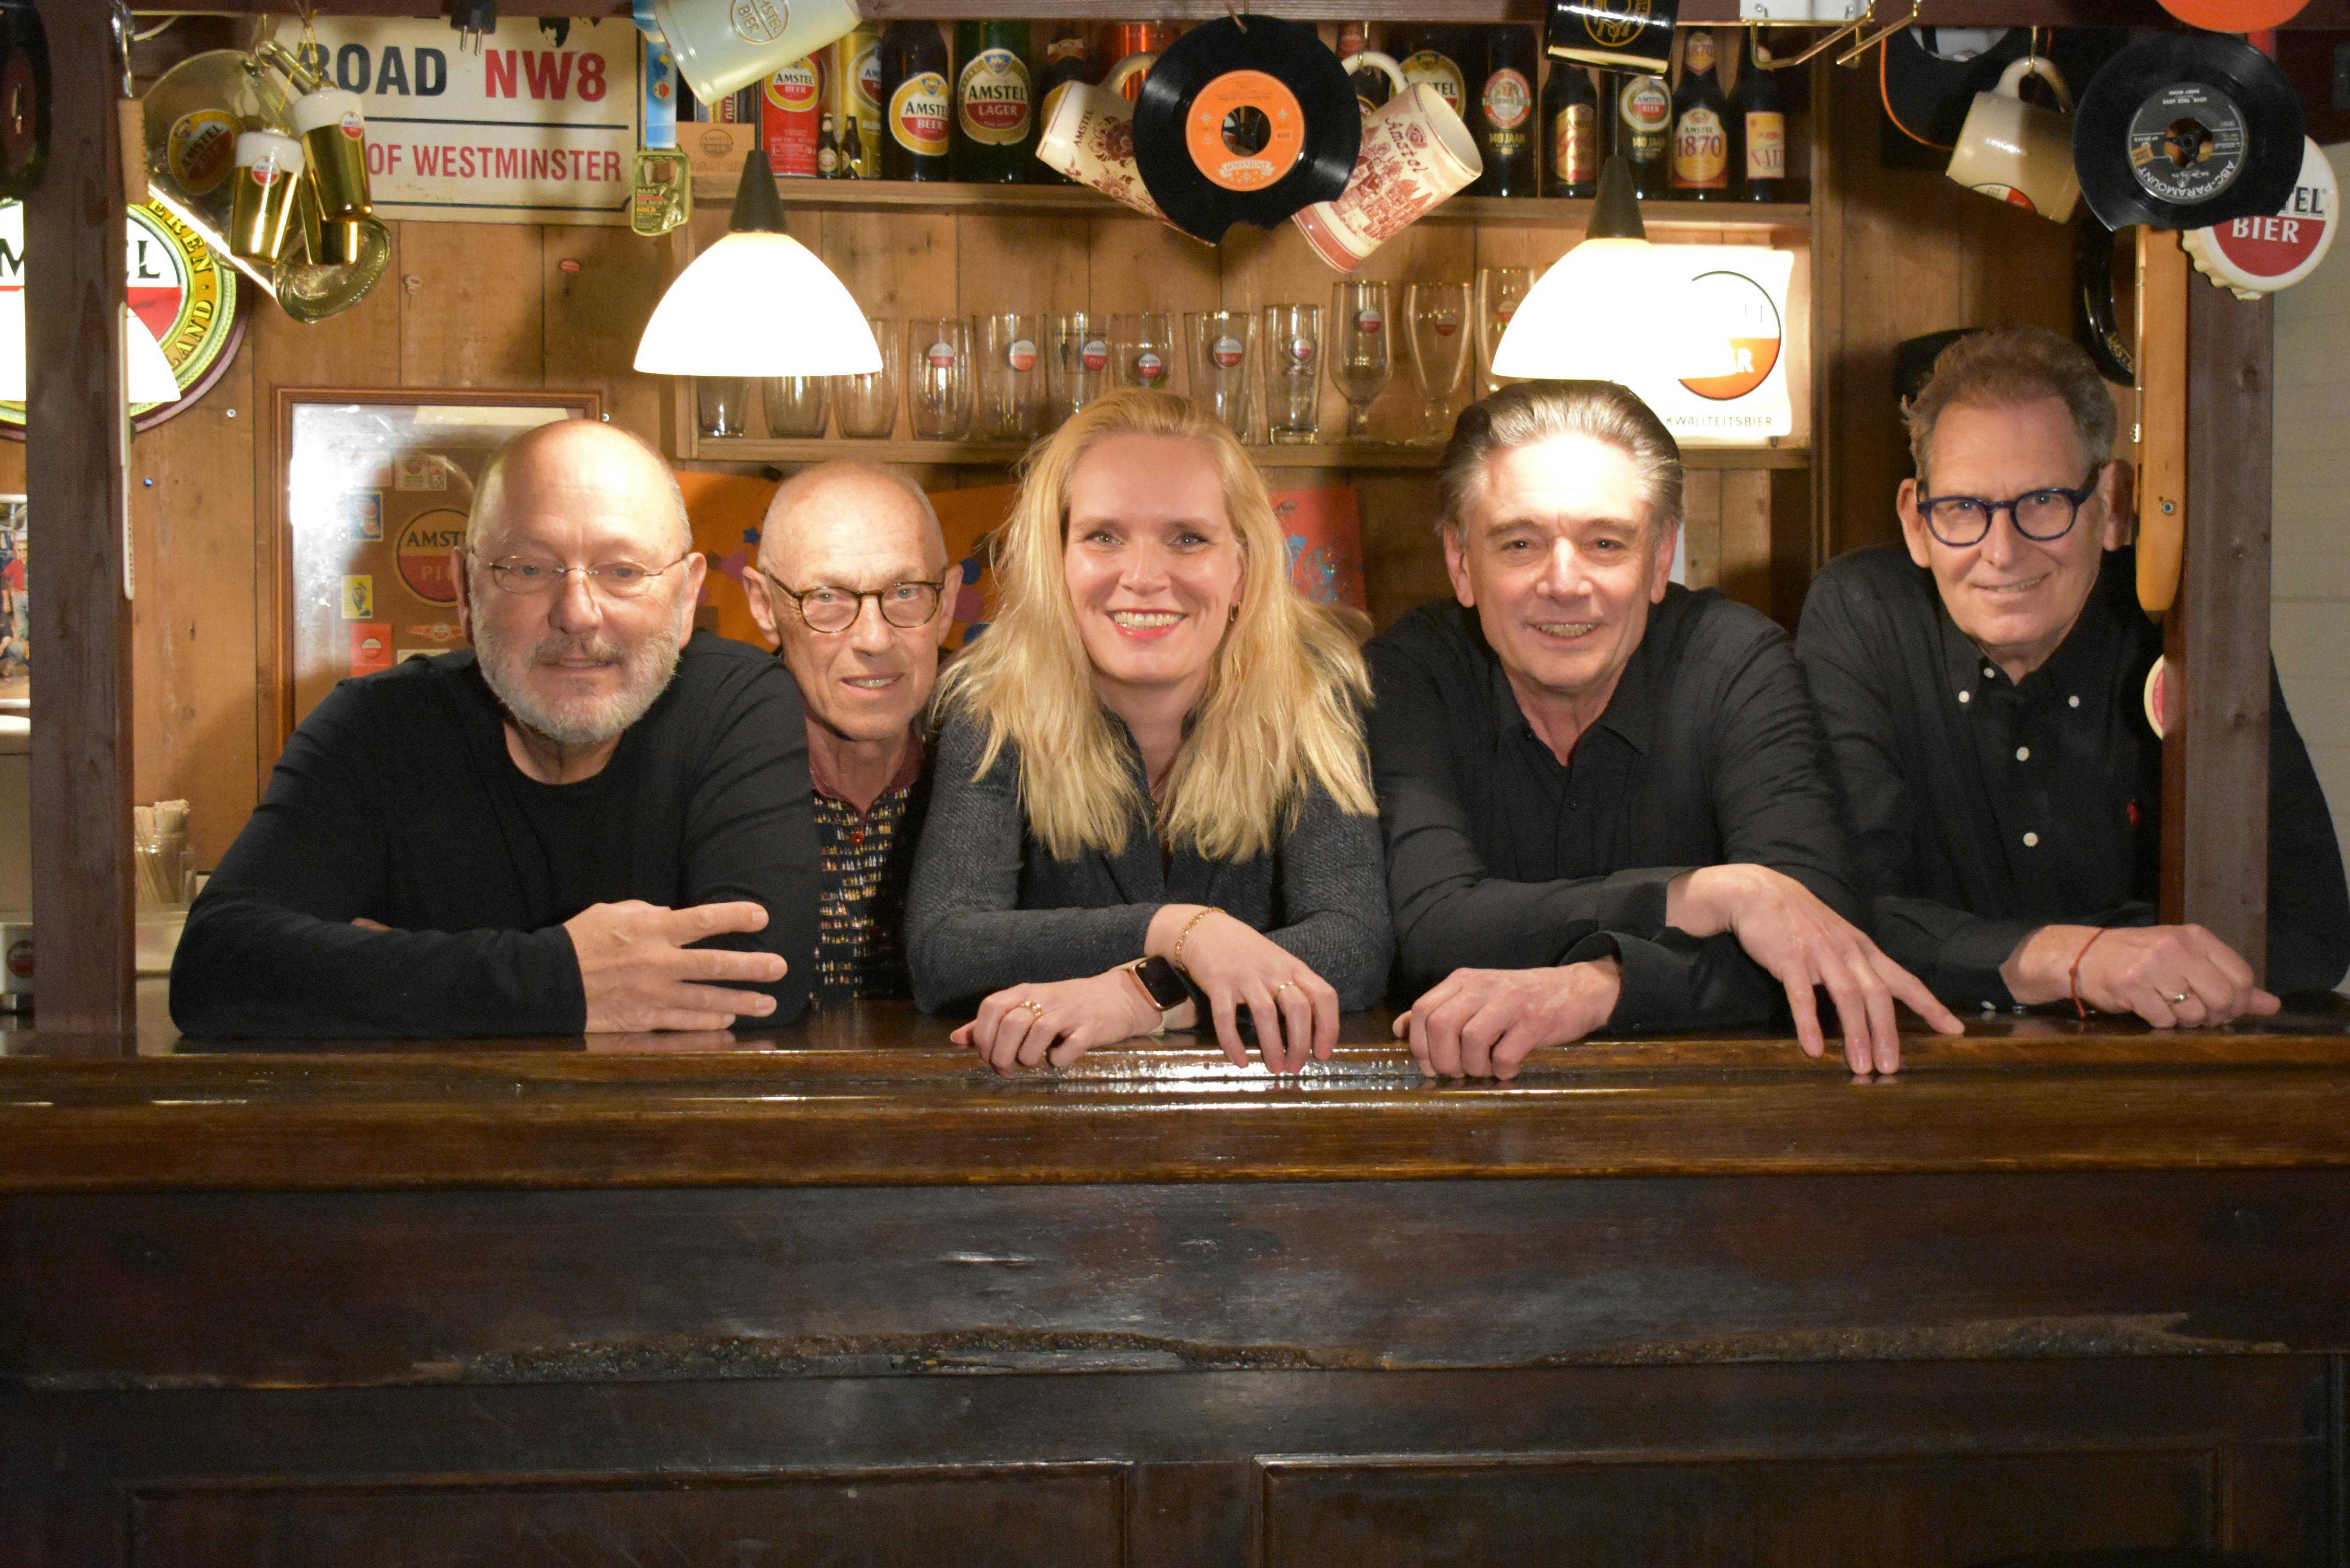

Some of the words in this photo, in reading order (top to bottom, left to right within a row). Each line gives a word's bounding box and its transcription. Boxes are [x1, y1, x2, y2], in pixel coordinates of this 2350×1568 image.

[738, 4, 759, 33] BIER
[485, 49, 606, 102] NW8
[776, 73, 813, 85] AMSTEL
[969, 85, 1025, 101] AMSTEL
[978, 105, 1017, 116] LAGER
[918, 120, 943, 131] BEER
[1074, 110, 1093, 147] AMSTEL
[1677, 135, 1722, 157] 1870
[366, 143, 402, 176] OF
[413, 145, 621, 182] WESTMINSTER
[2138, 160, 2236, 198] ABC-PARAMOUNT
[2232, 216, 2299, 243] BIER
[1666, 416, 1772, 426] KWALITEITSBIER
